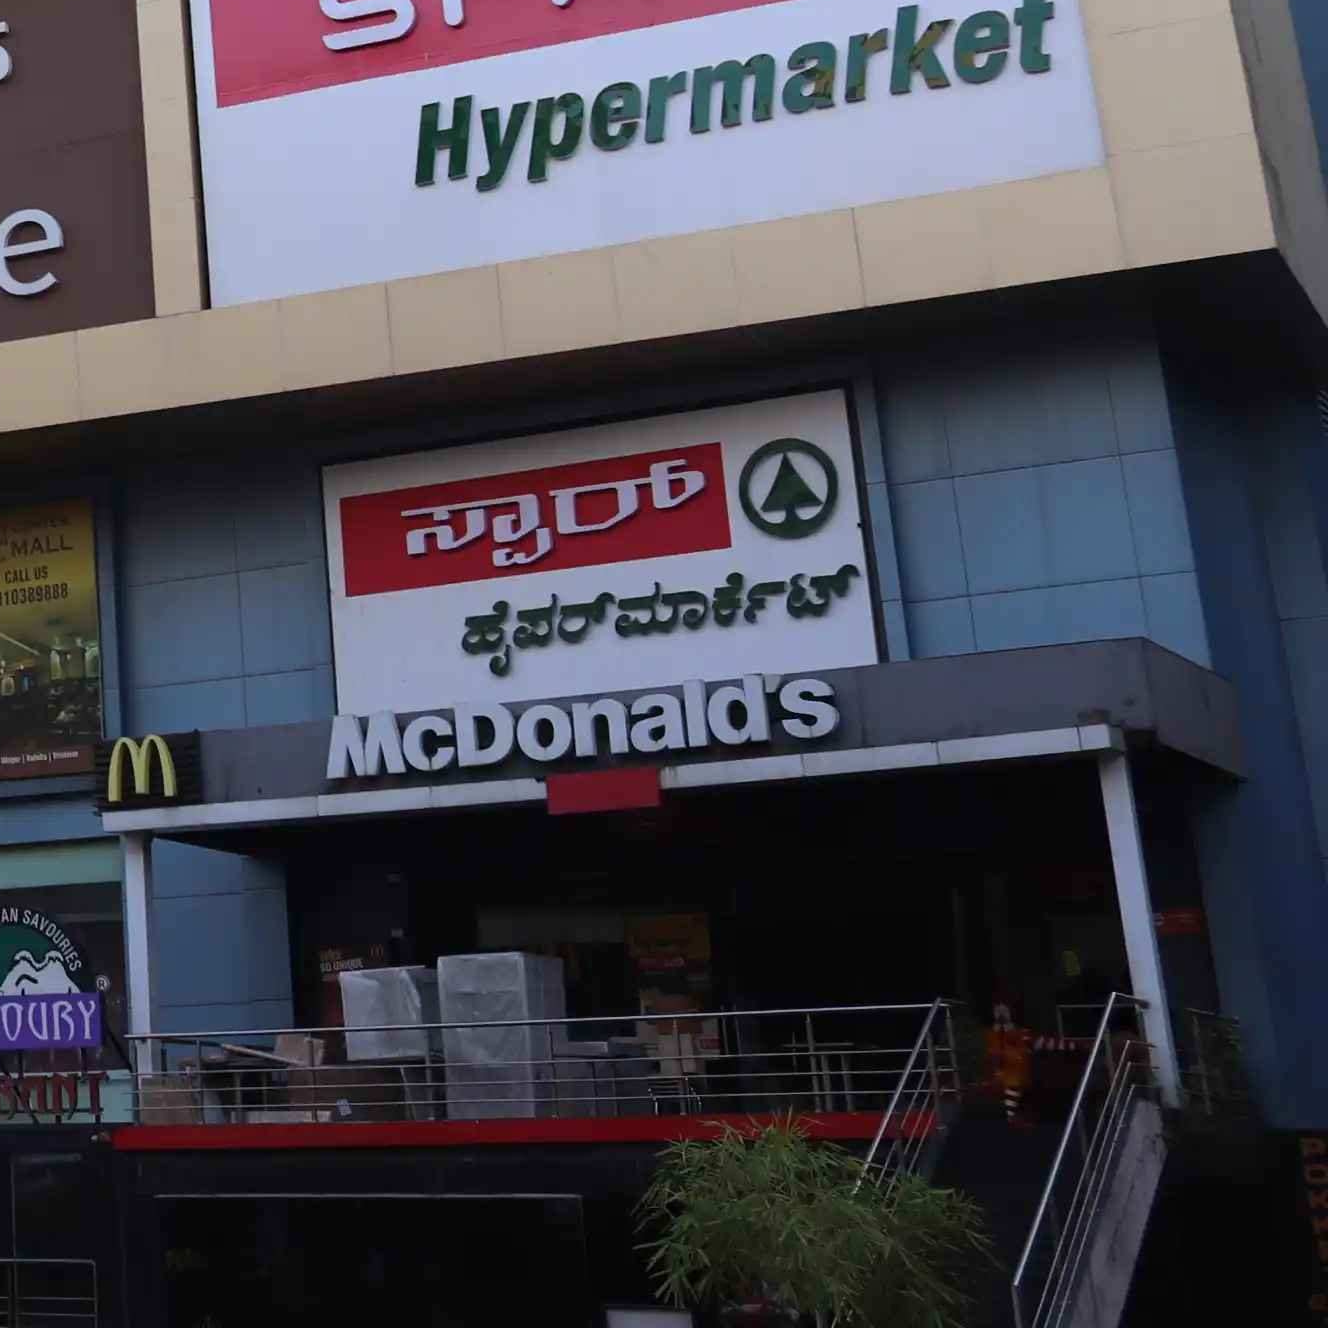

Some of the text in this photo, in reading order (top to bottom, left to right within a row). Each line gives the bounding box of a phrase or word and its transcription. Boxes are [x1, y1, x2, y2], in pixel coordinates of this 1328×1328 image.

[11, 535, 75, 558] MALL
[5, 565, 49, 584] CALL US
[326, 673, 841, 780] McDonald's
[21, 908, 83, 974] SAVOURIES
